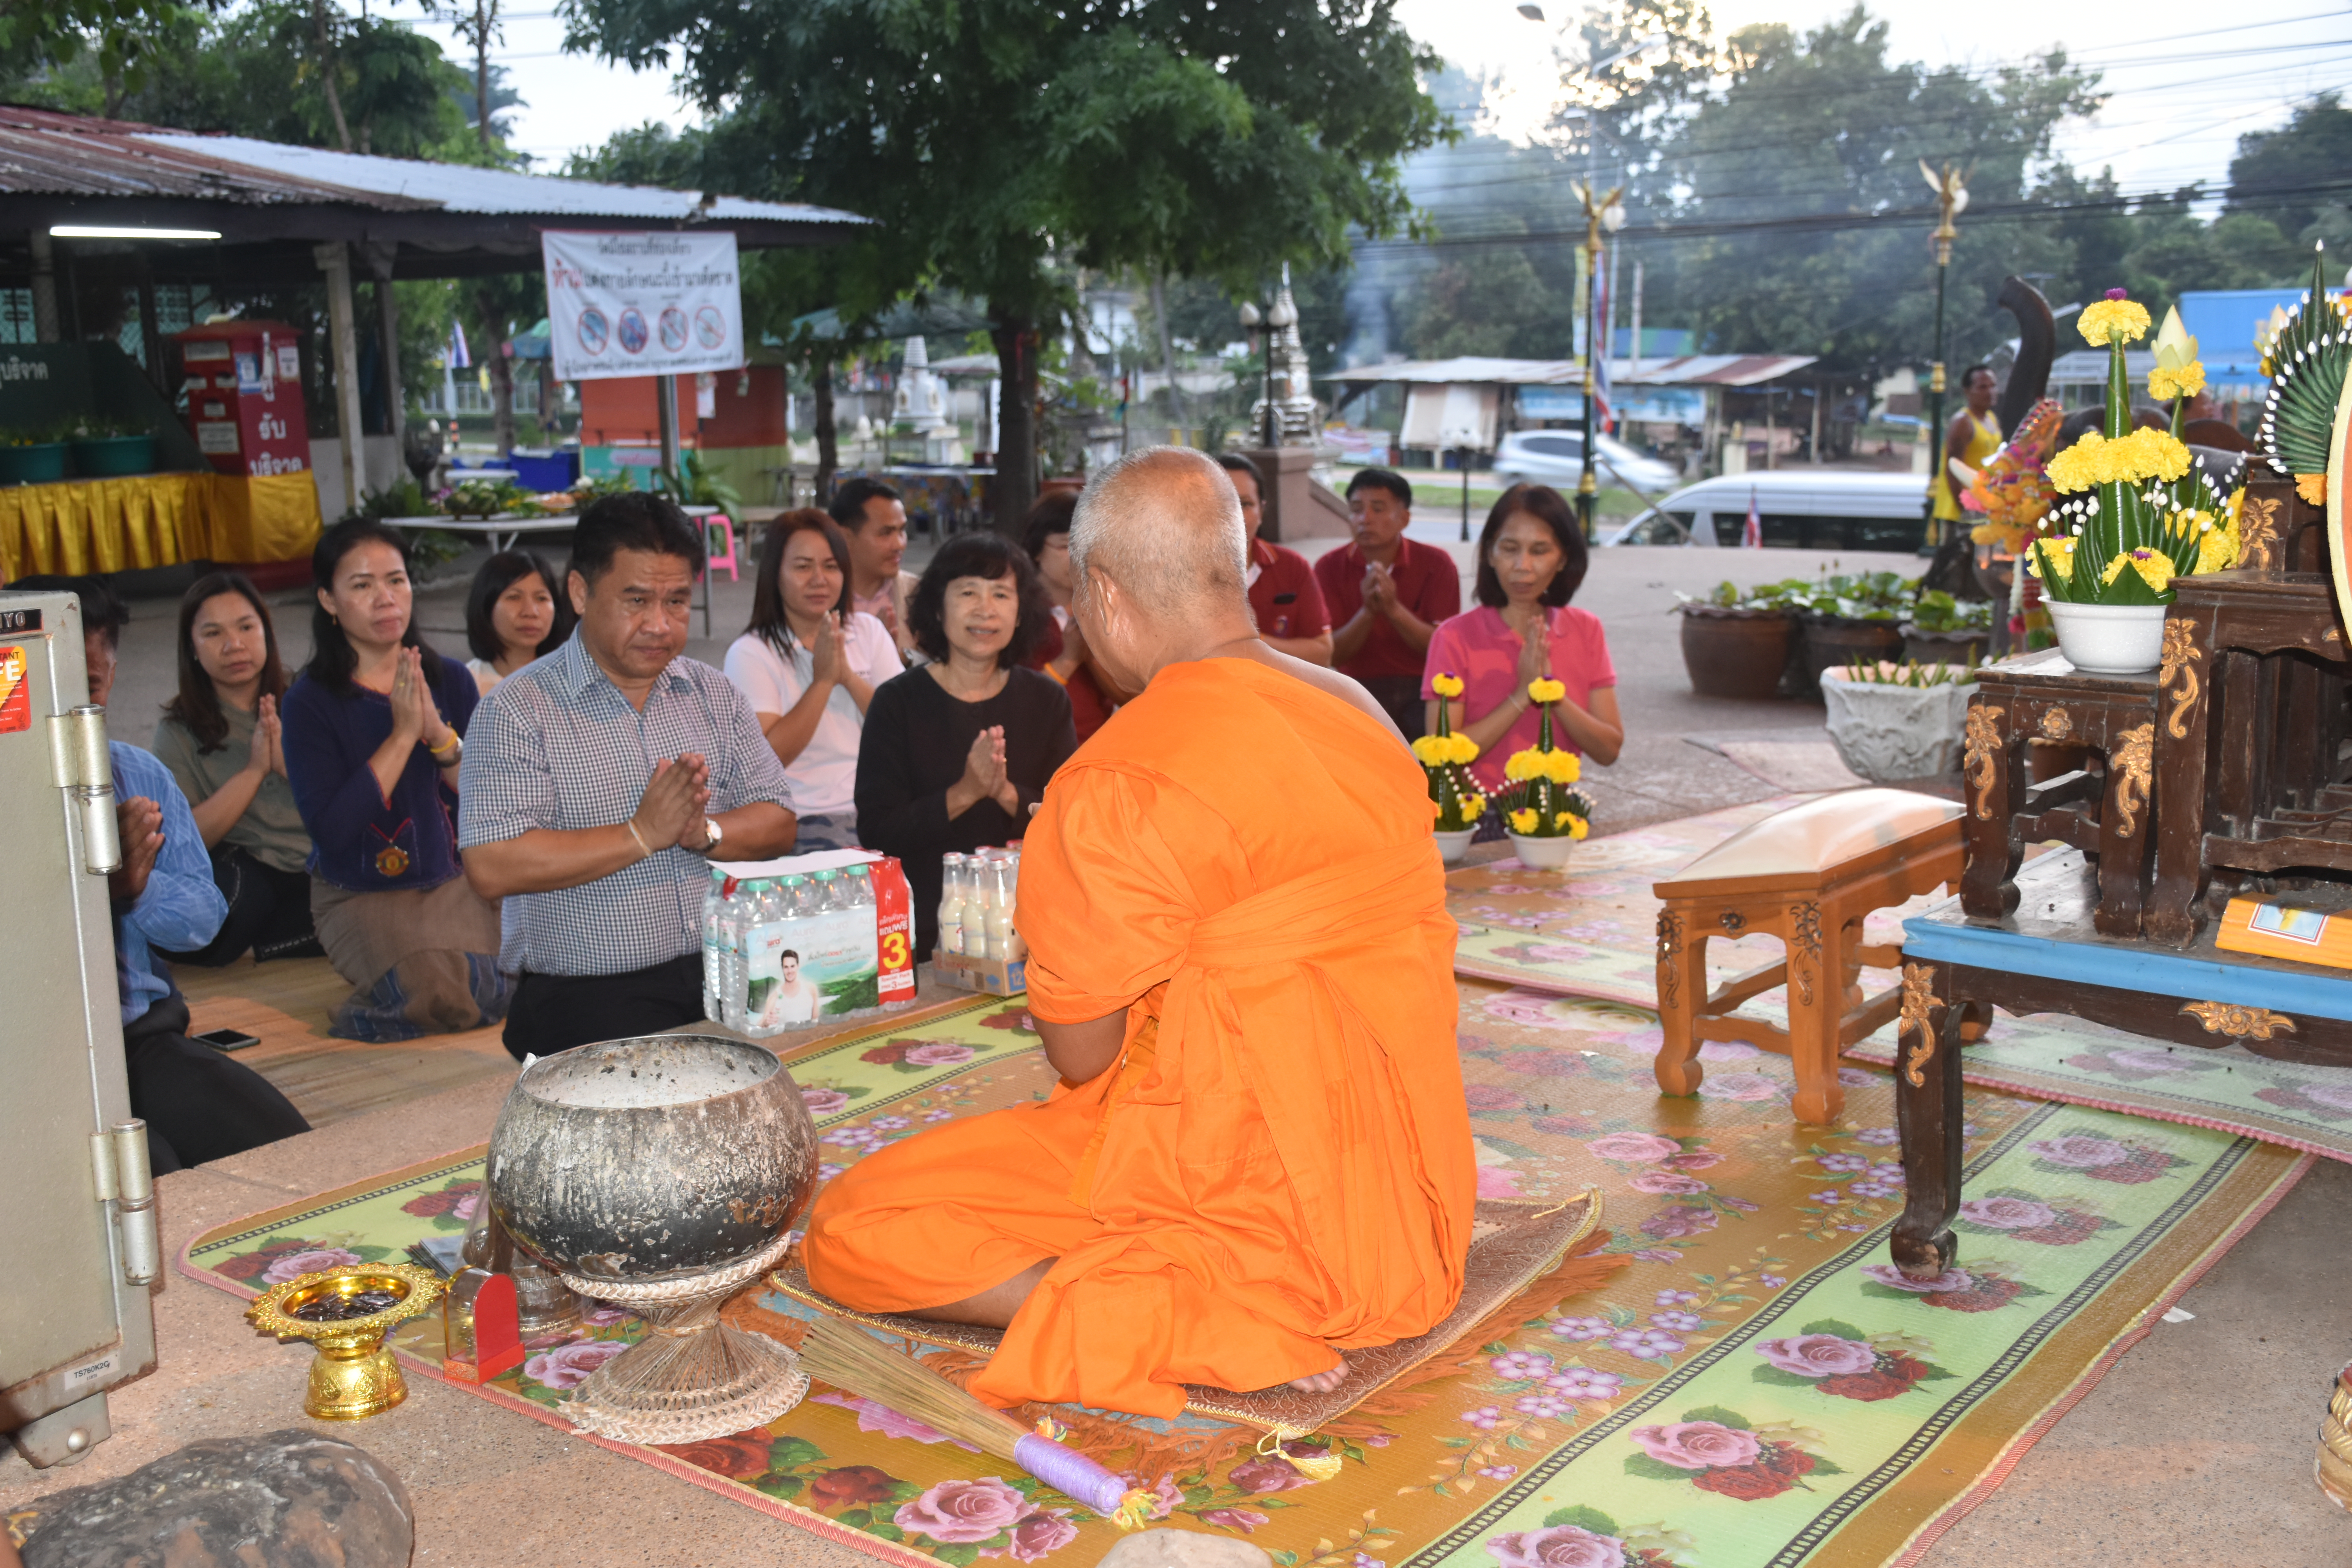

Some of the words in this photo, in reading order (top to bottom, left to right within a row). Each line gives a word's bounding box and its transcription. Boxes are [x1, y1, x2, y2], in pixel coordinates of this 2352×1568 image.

[0, 354, 49, 389] บริจาค
[259, 412, 287, 440] รับ
[0, 612, 26, 628] YO
[883, 932, 907, 969] 3
[892, 981, 897, 989] 3
